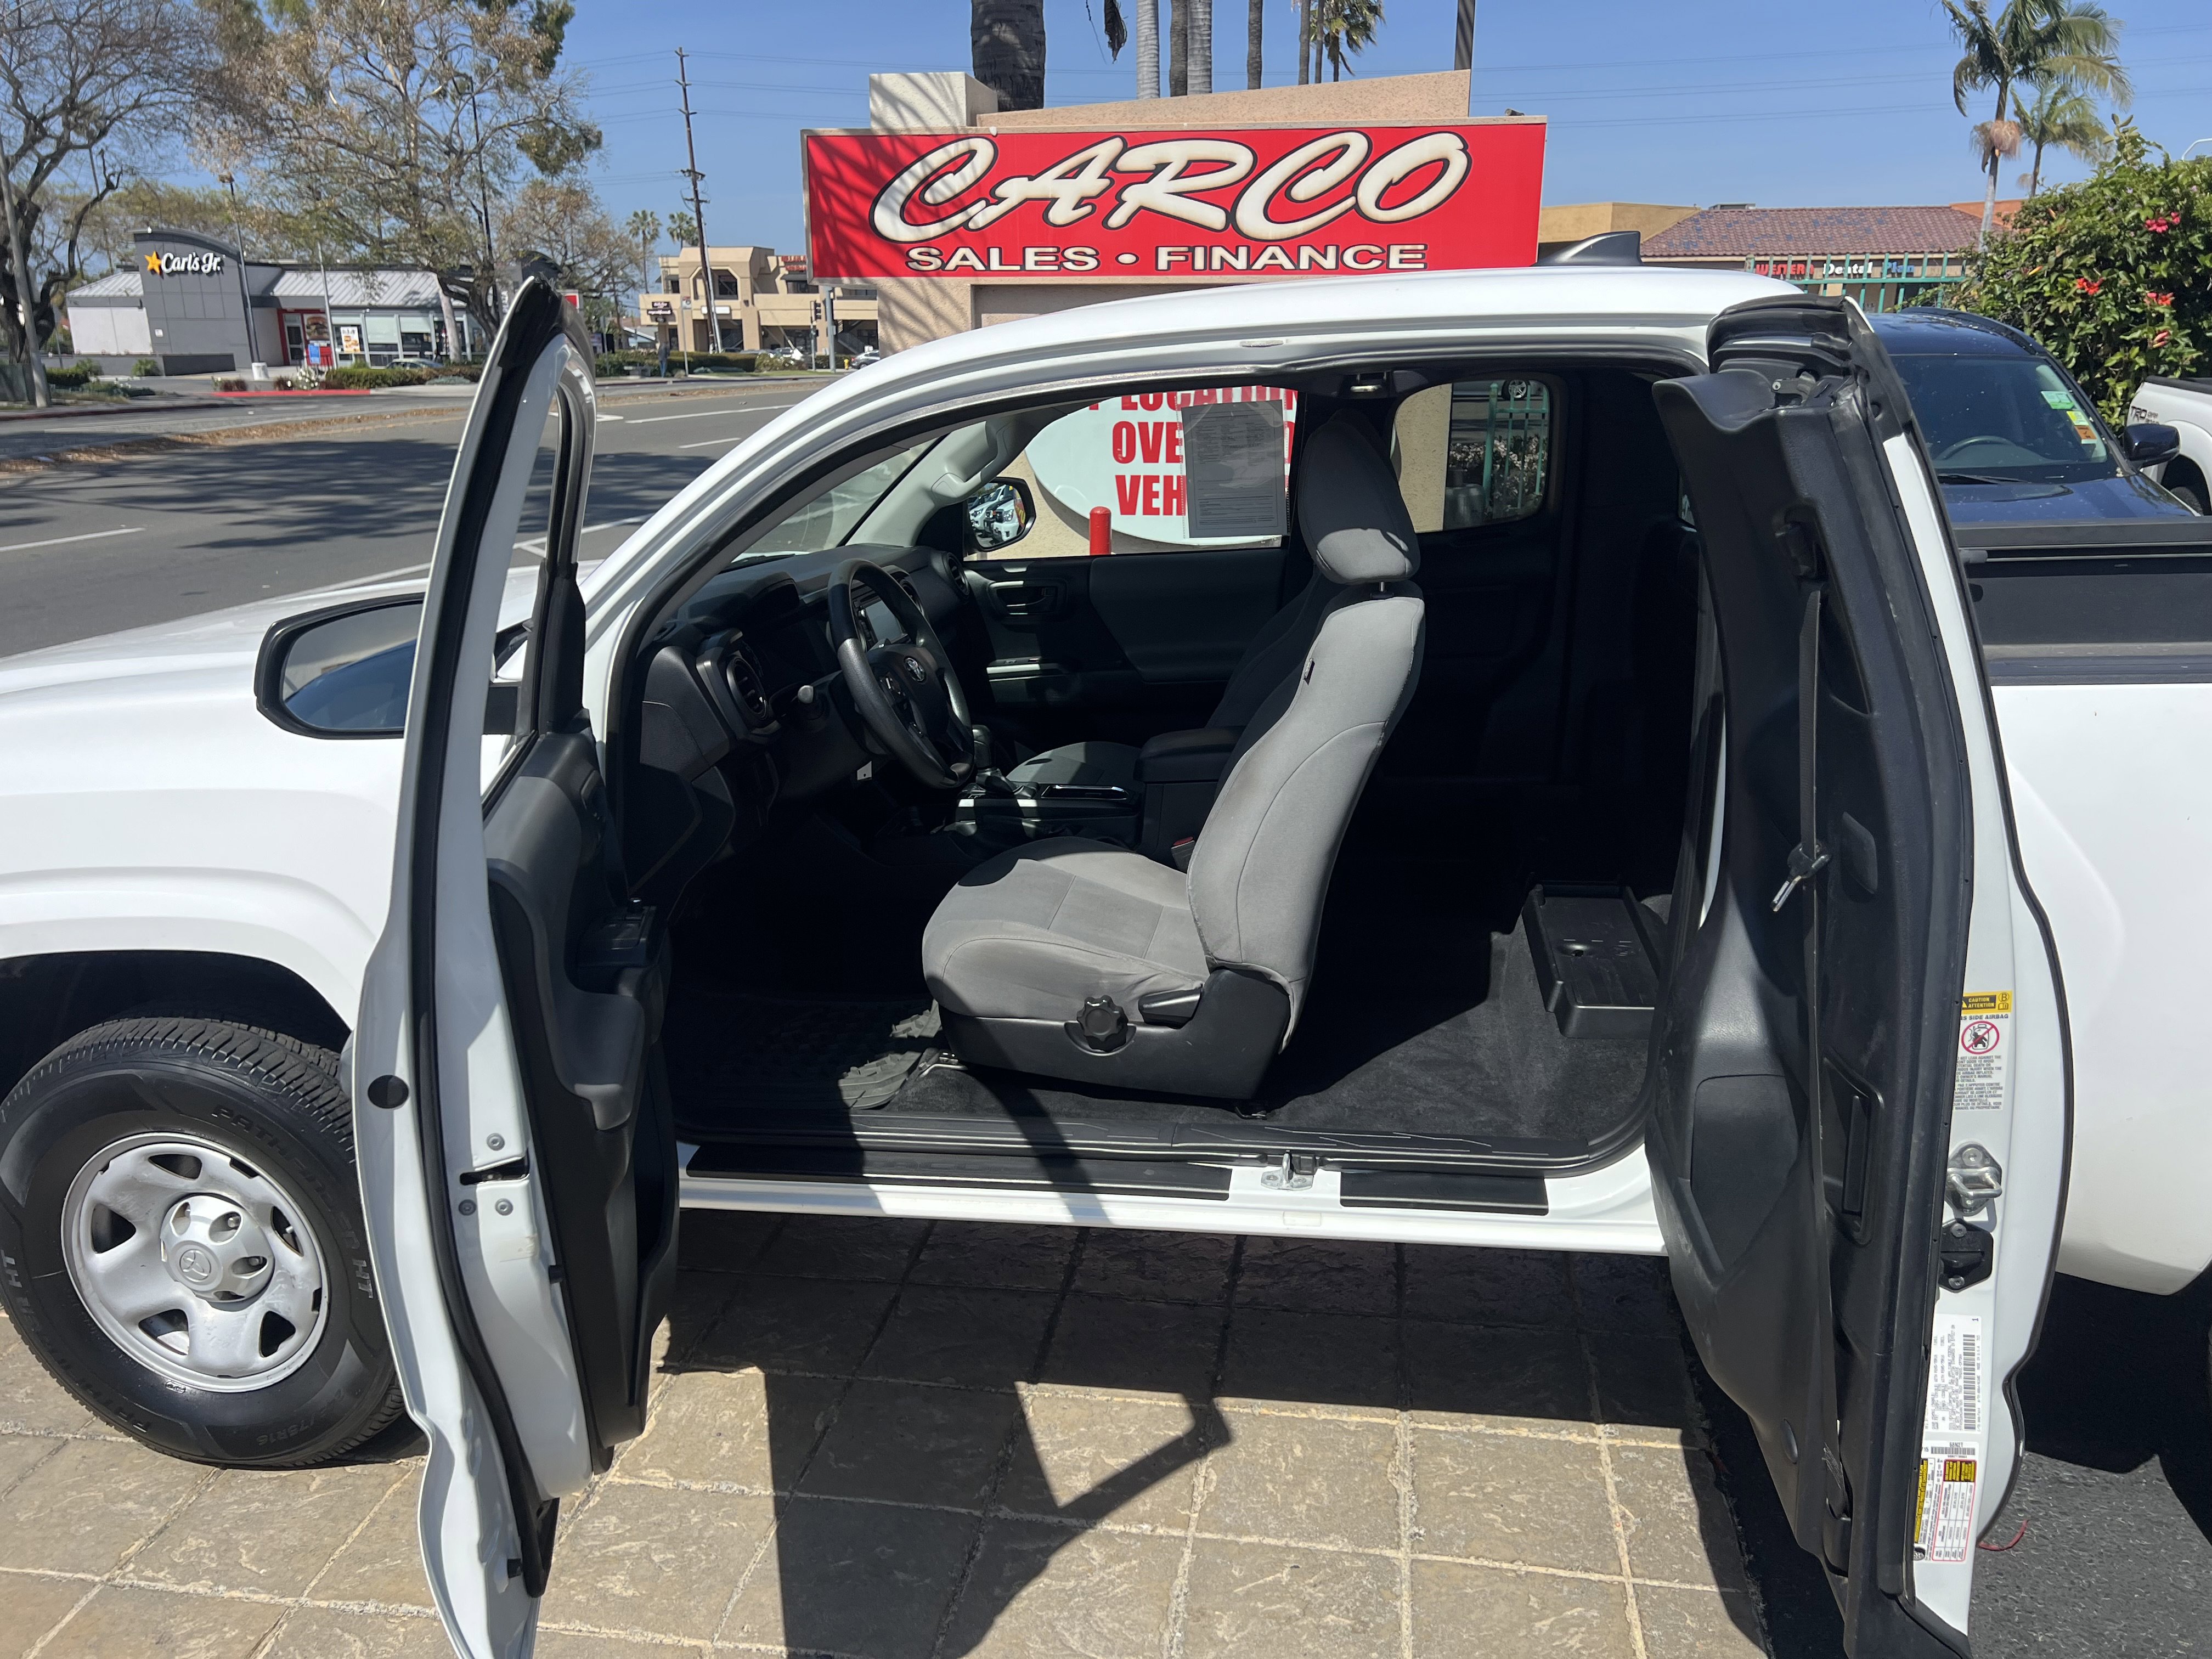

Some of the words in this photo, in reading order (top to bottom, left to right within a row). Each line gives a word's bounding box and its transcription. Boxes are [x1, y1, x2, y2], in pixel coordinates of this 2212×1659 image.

[871, 132, 1470, 242] CARCO
[161, 252, 200, 273] Carl's
[201, 252, 221, 274] Jr.
[906, 245, 1099, 272] SALES
[1155, 243, 1427, 271] FINANCE
[1822, 261, 1873, 275] Dental
[1112, 420, 1184, 464] OVE
